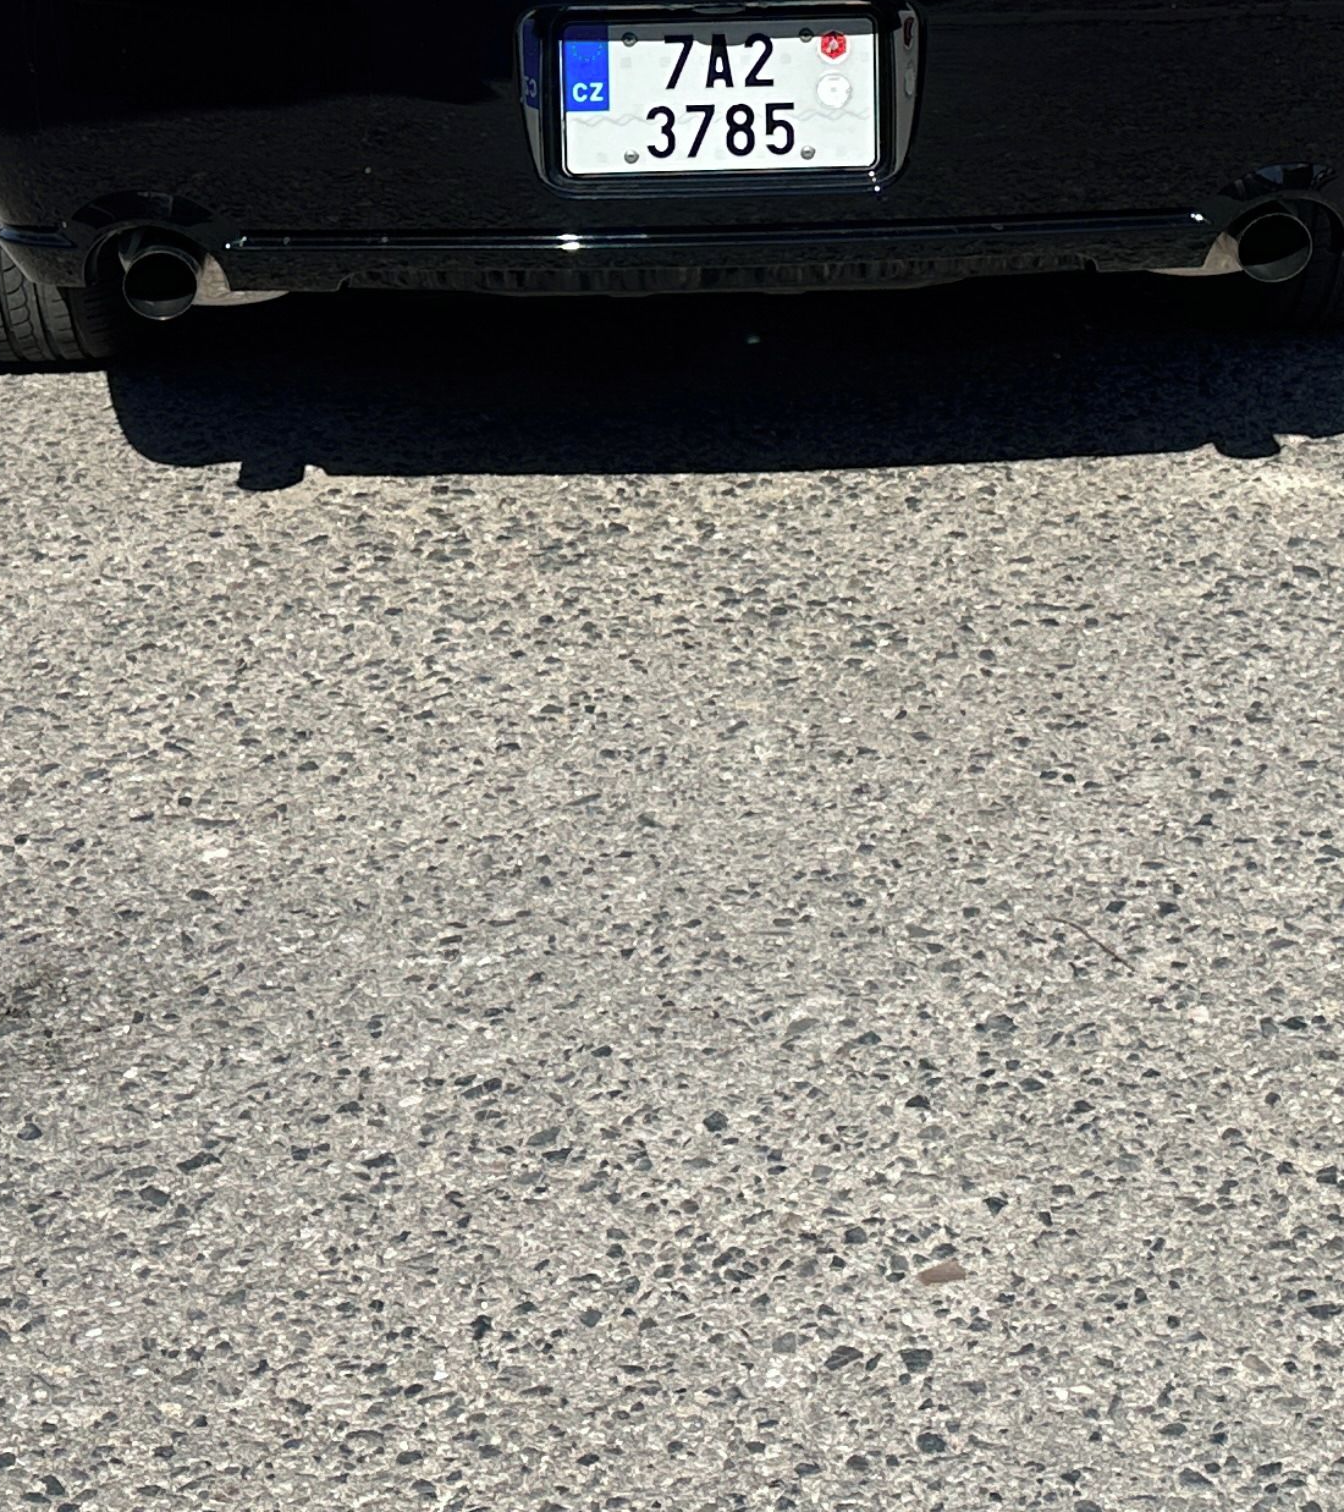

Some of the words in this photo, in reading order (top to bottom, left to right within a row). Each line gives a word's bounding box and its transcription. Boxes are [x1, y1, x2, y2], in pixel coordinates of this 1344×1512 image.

[664, 33, 775, 90] 7A2
[572, 81, 605, 103] CZ
[646, 102, 796, 159] 3785
